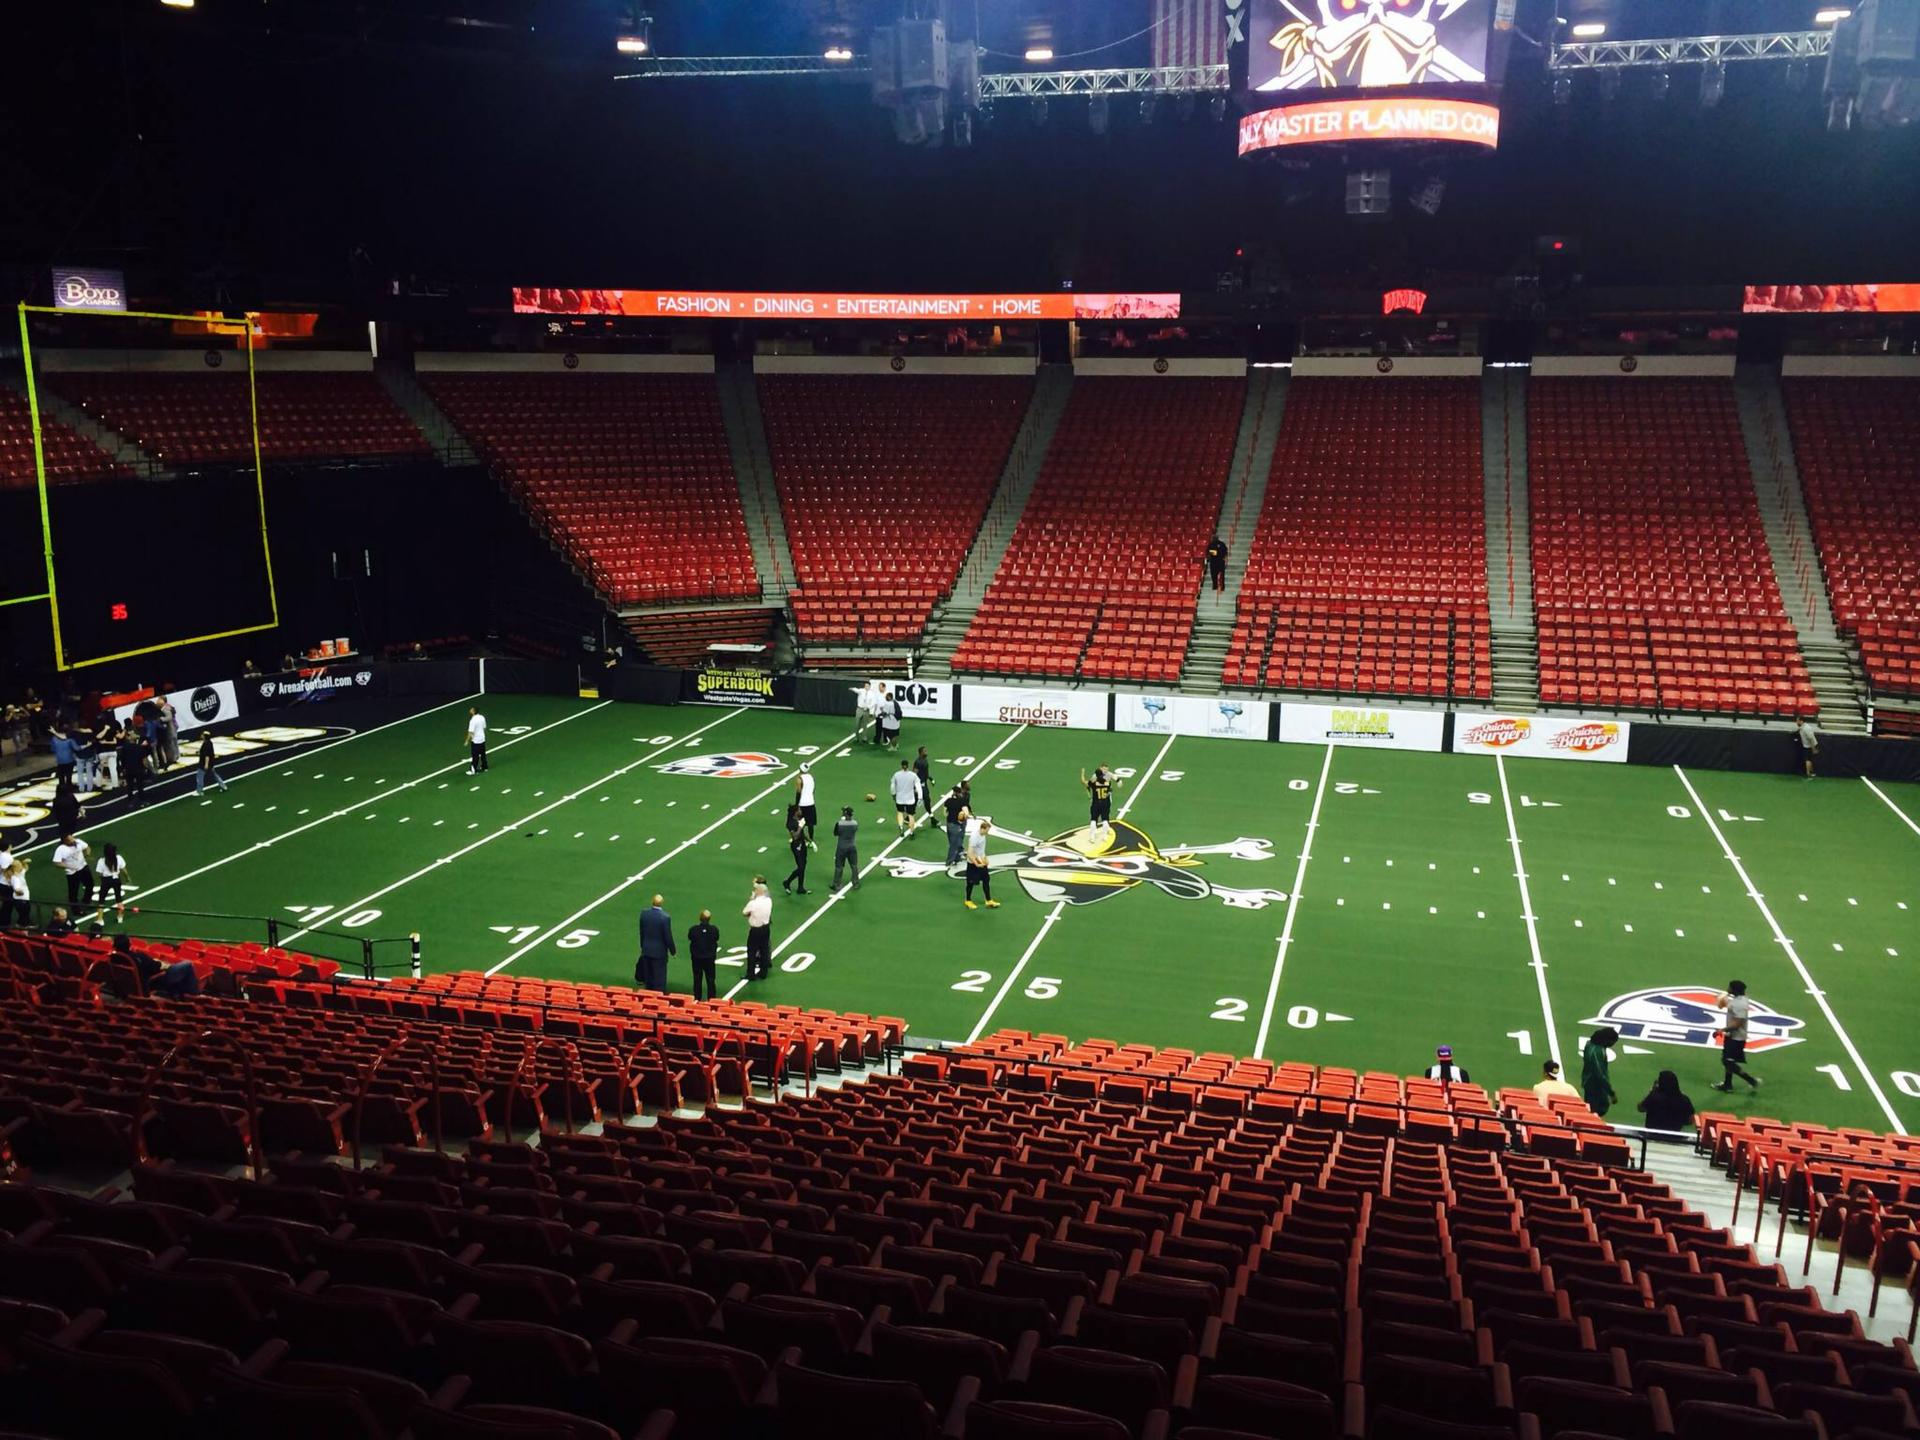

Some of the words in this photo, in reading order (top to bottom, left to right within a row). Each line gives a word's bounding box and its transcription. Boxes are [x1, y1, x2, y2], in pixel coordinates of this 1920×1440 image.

[1263, 111, 1342, 139] MASTER
[1348, 108, 1457, 132] PLANNED
[66, 283, 119, 300] BOYD
[657, 296, 730, 313] FASHION
[754, 298, 814, 314] DINING
[837, 299, 970, 315] ENTERTAINMENT
[992, 299, 1041, 315] HOME
[112, 604, 128, 620] 35
[279, 675, 352, 695] ArenaFootball.com
[698, 674, 774, 697] SUPERBOOK
[194, 694, 217, 711] Distill
[703, 695, 766, 704] WestgateVegas.com
[999, 701, 1068, 723] grinders
[1472, 728, 1531, 744] Burgers
[1557, 732, 1619, 749] Burgers
